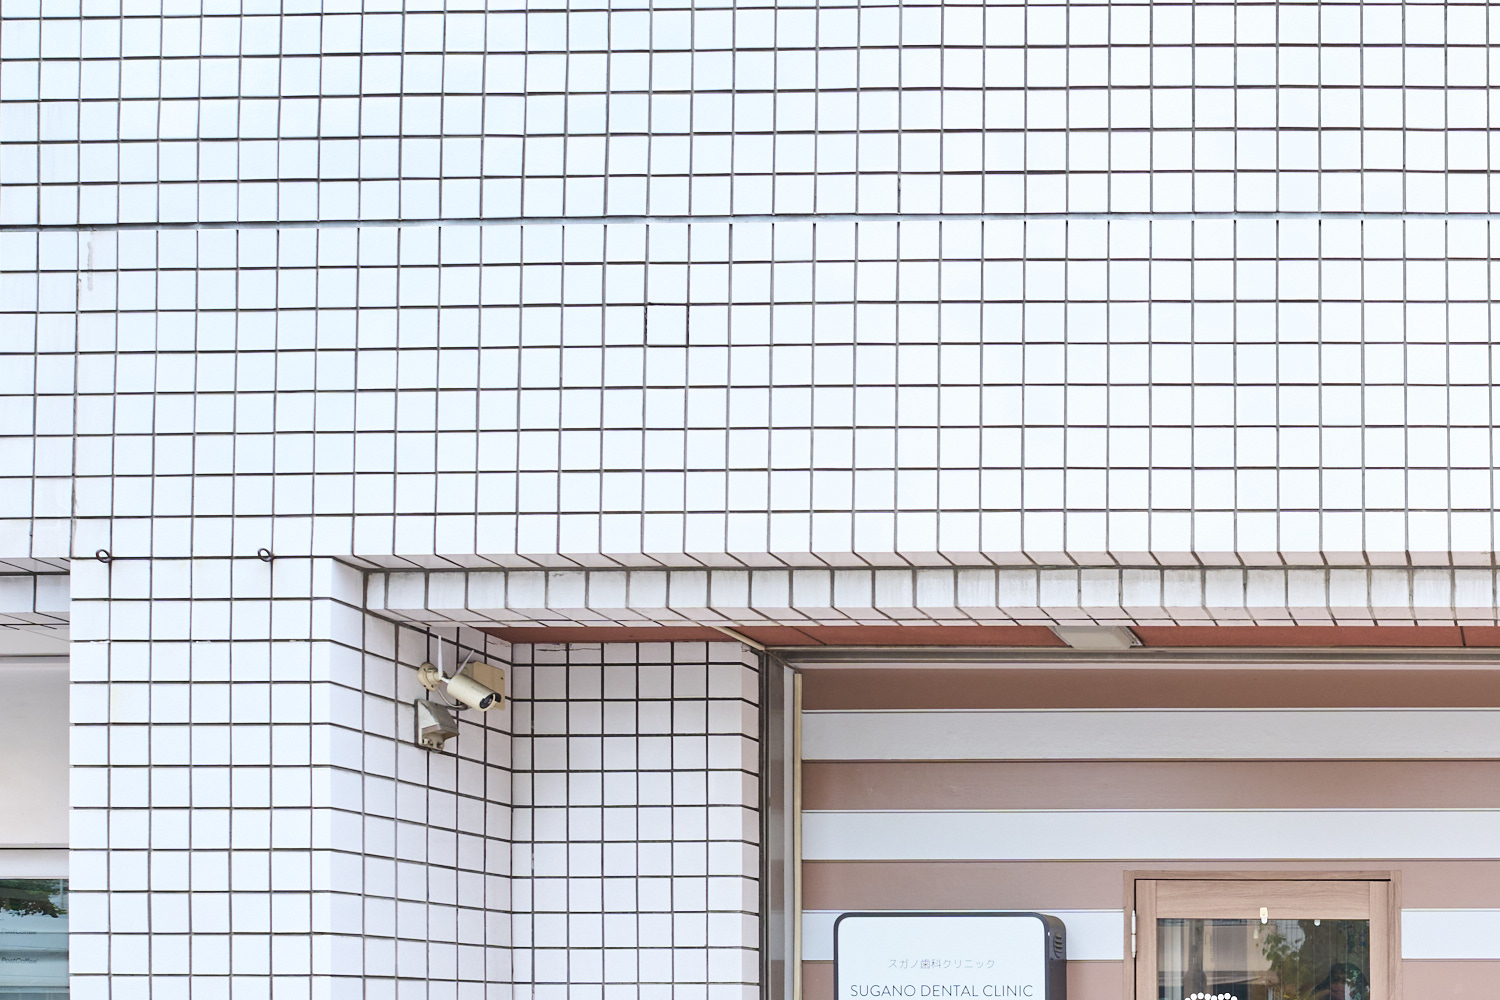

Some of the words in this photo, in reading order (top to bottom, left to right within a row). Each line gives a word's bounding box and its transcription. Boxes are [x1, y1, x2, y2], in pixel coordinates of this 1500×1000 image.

[888, 959, 996, 969] スガノ歯科クリニック
[850, 984, 916, 997] SUGANO
[920, 984, 979, 997] DENTAL
[982, 984, 1034, 997] CLINIC
